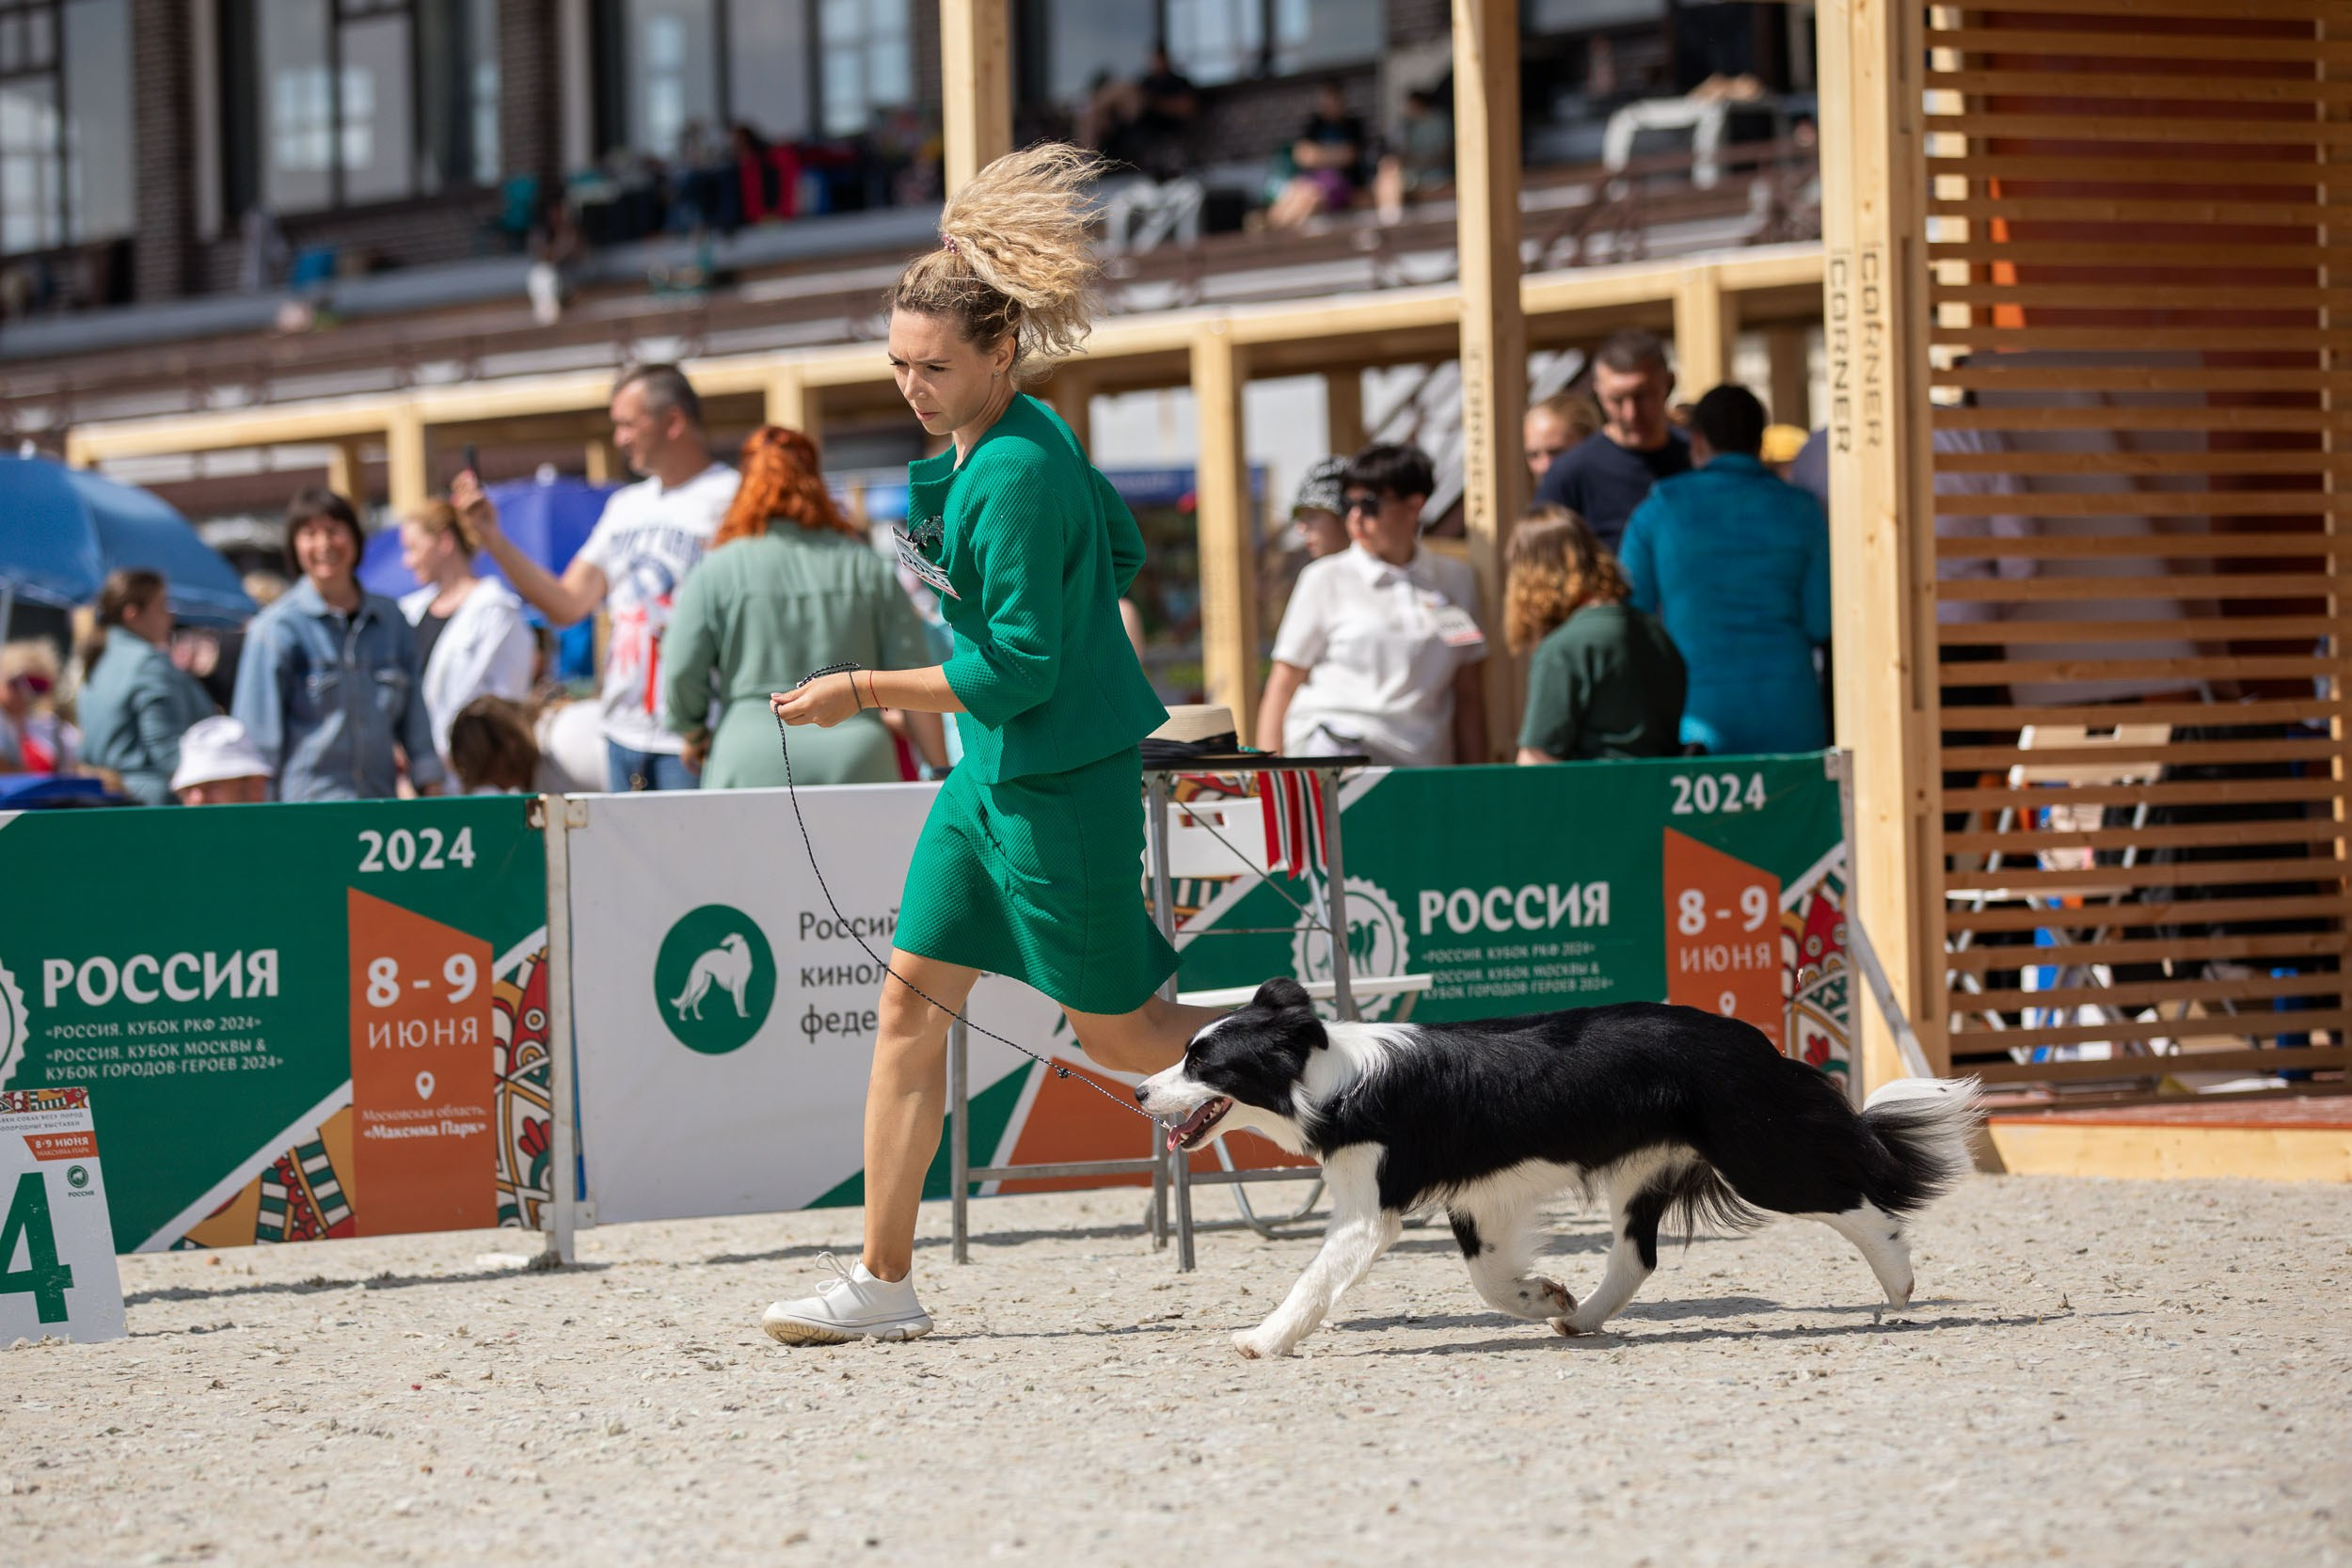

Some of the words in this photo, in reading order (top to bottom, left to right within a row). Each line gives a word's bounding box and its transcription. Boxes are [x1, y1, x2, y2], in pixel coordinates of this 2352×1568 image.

[1670, 772, 1767, 815] 2024
[358, 827, 476, 872] 2024
[1419, 880, 1610, 936] РОССИЯ
[1680, 942, 1772, 973] ИЮНЯ
[43, 948, 278, 1007] РОССИЯ
[127, 1020, 180, 1036] КУБОК
[184, 1018, 215, 1033] РКФ
[369, 1017, 478, 1050] ИЮНЯ
[128, 1043, 180, 1059] КУБОК
[184, 1039, 252, 1056] МОСКВЫ
[255, 1037, 267, 1052] &
[45, 1064, 99, 1082] КУБОК
[102, 1057, 237, 1079] ГОРОДОВ-ГЕРОЕВ
[55, 1136, 89, 1147] ИЮНЯ
[0, 1171, 74, 1324] 4
